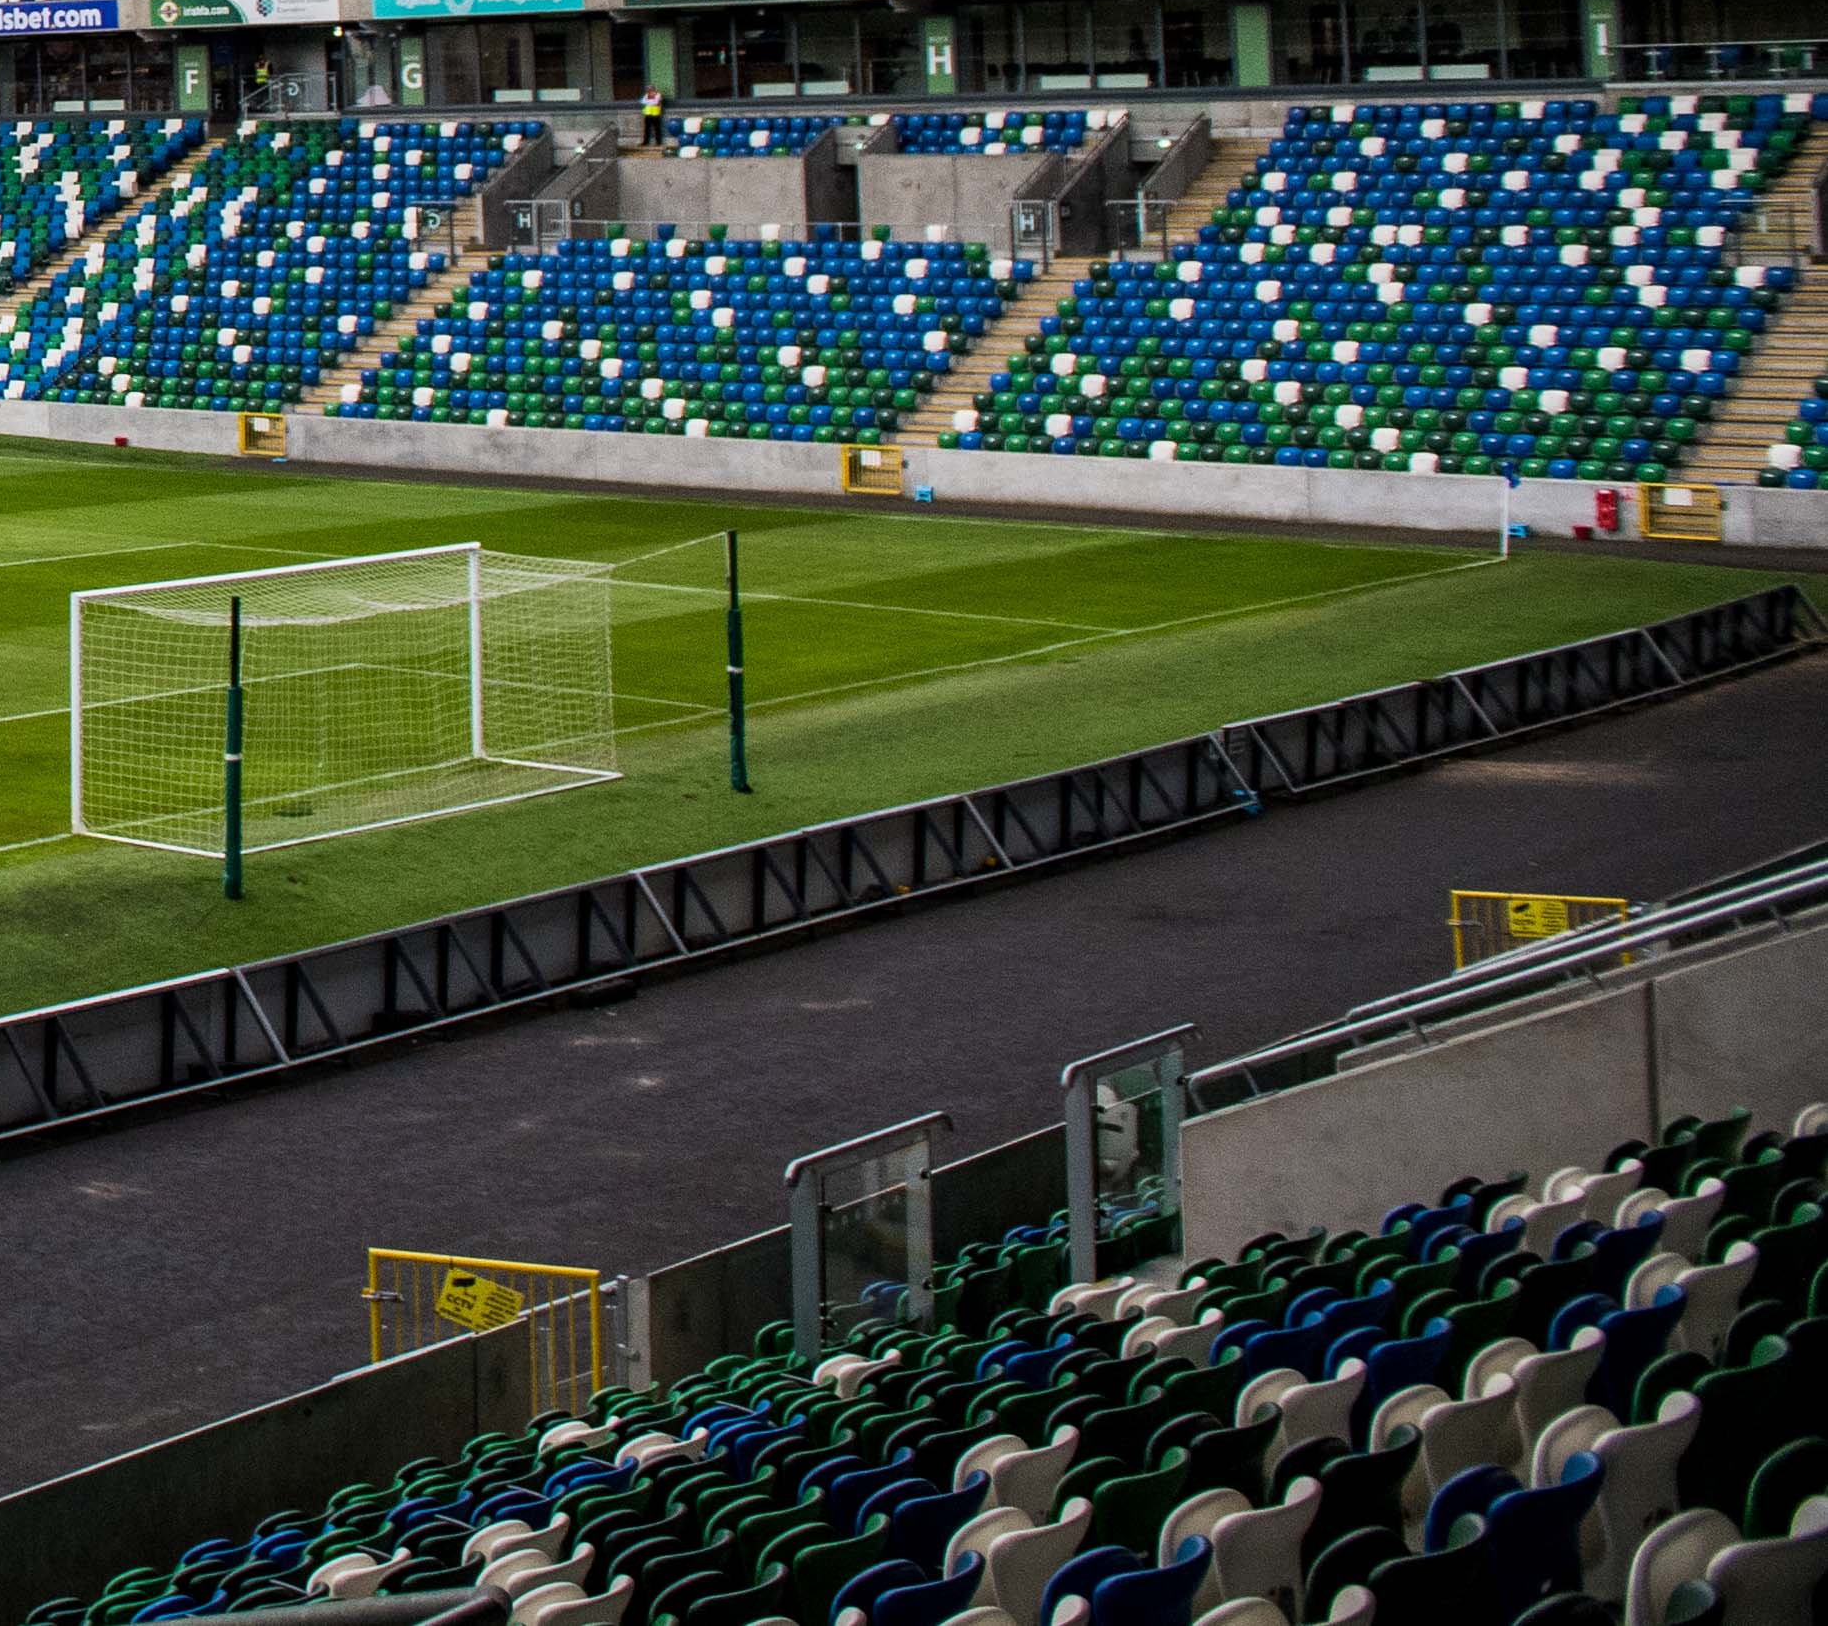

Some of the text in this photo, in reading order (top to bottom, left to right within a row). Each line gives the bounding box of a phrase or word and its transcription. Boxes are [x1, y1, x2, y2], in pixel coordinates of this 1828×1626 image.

[929, 45, 952, 75] H
[185, 69, 199, 95] F
[402, 62, 422, 89] G
[517, 213, 531, 228] H
[1019, 213, 1035, 231] H
